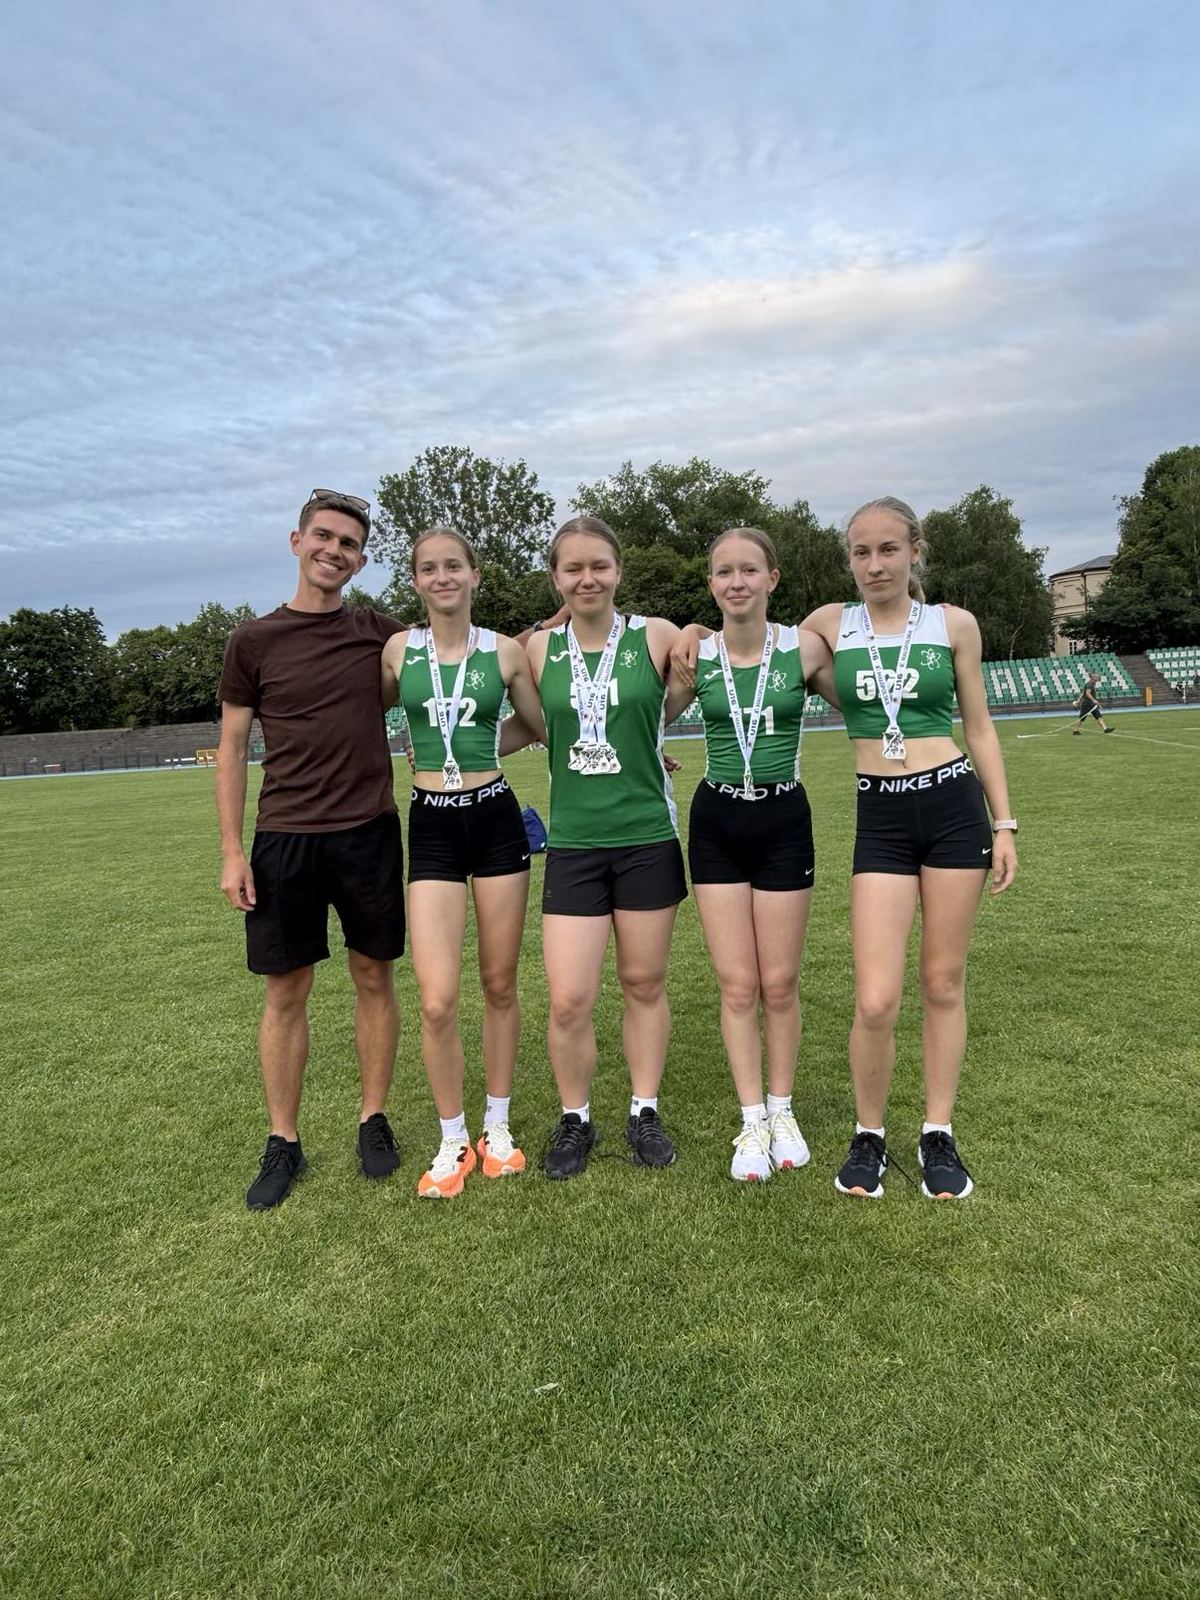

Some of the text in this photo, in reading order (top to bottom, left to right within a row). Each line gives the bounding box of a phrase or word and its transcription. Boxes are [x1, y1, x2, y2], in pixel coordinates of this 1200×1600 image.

[895, 673, 904, 690] U16
[587, 692, 595, 708] U16
[729, 690, 737, 705] U16
[422, 697, 477, 727] 12
[750, 719, 758, 736] U16
[879, 773, 933, 793] NIKE
[424, 793, 474, 807] NIKE
[477, 778, 509, 802] PRO
